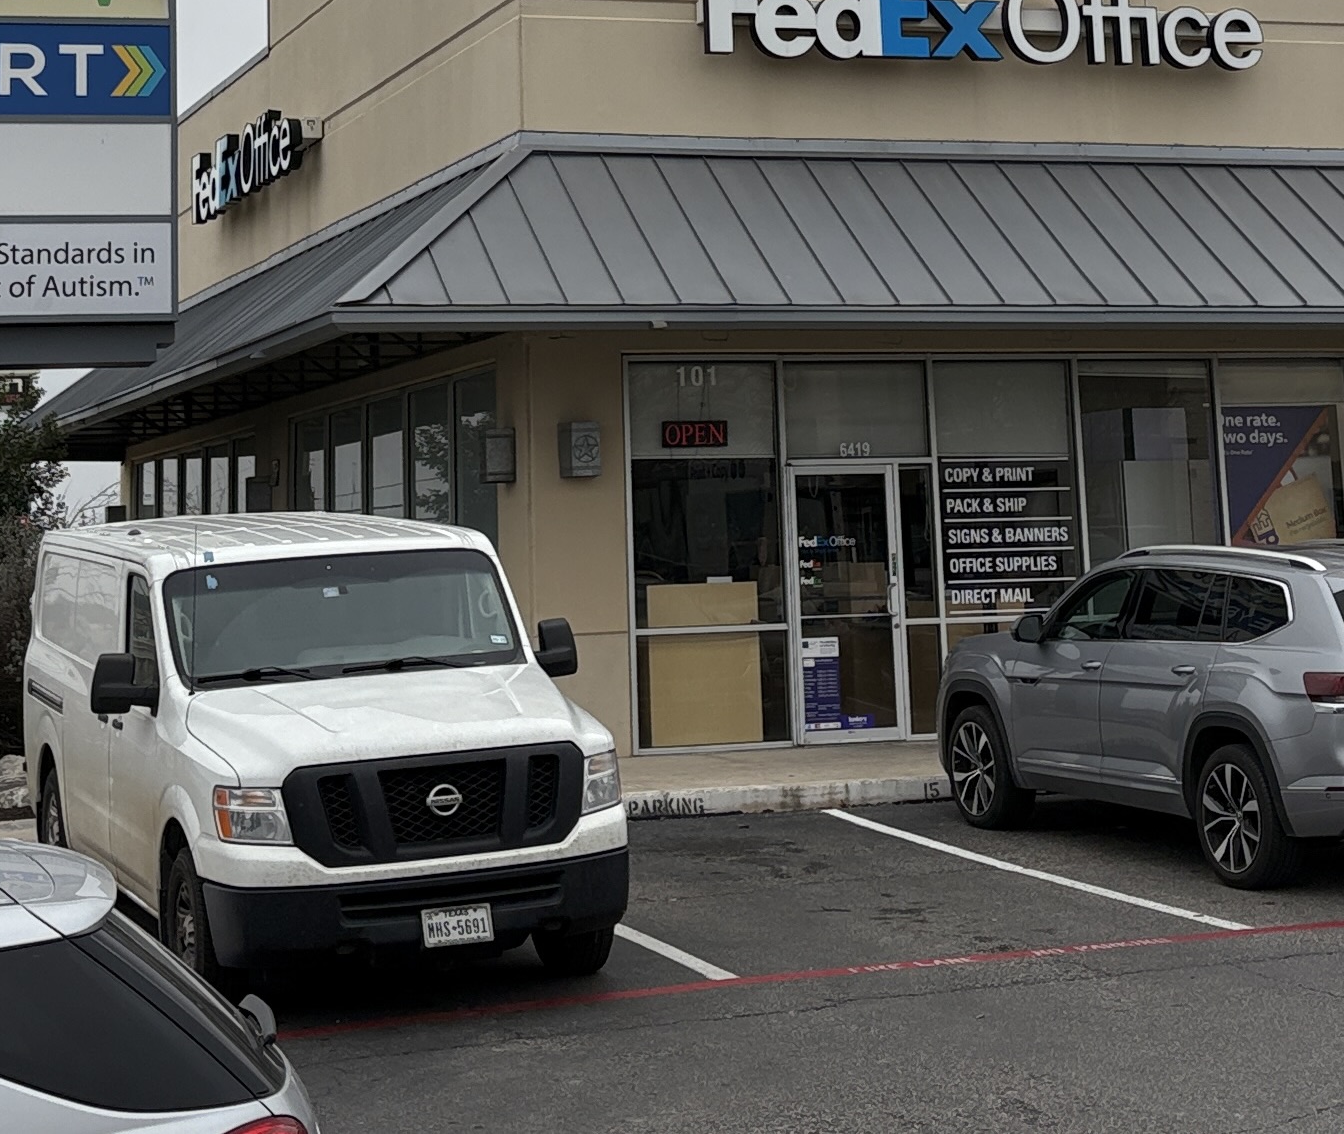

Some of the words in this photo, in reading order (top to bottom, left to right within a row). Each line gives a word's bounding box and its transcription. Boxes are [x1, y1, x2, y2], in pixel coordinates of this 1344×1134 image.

[192, 134, 240, 224] FedEx
[239, 111, 296, 194] Office
[133, 242, 156, 264] in
[8, 274, 37, 298] of
[676, 365, 718, 387] 101
[1246, 412, 1281, 427] rate.
[665, 423, 724, 445] OPEN
[1223, 432, 1247, 444] wo
[1249, 429, 1289, 447] days.
[840, 441, 871, 457] 6419
[944, 467, 979, 483] COPY
[981, 467, 993, 483] &
[996, 467, 1035, 482] PRINT
[946, 498, 981, 513] PACK
[983, 498, 994, 513] &
[996, 497, 1027, 512] SHIP
[948, 529, 989, 544] SIGNS
[991, 528, 1003, 543] &
[1005, 526, 1069, 543] BANNERS
[949, 557, 993, 574] OFFICE
[996, 555, 1058, 572] SUPPLIES
[951, 588, 998, 605] DIRECT
[999, 587, 1035, 603] MAIL
[924, 781, 941, 800] 15
[627, 796, 705, 816] PARKING
